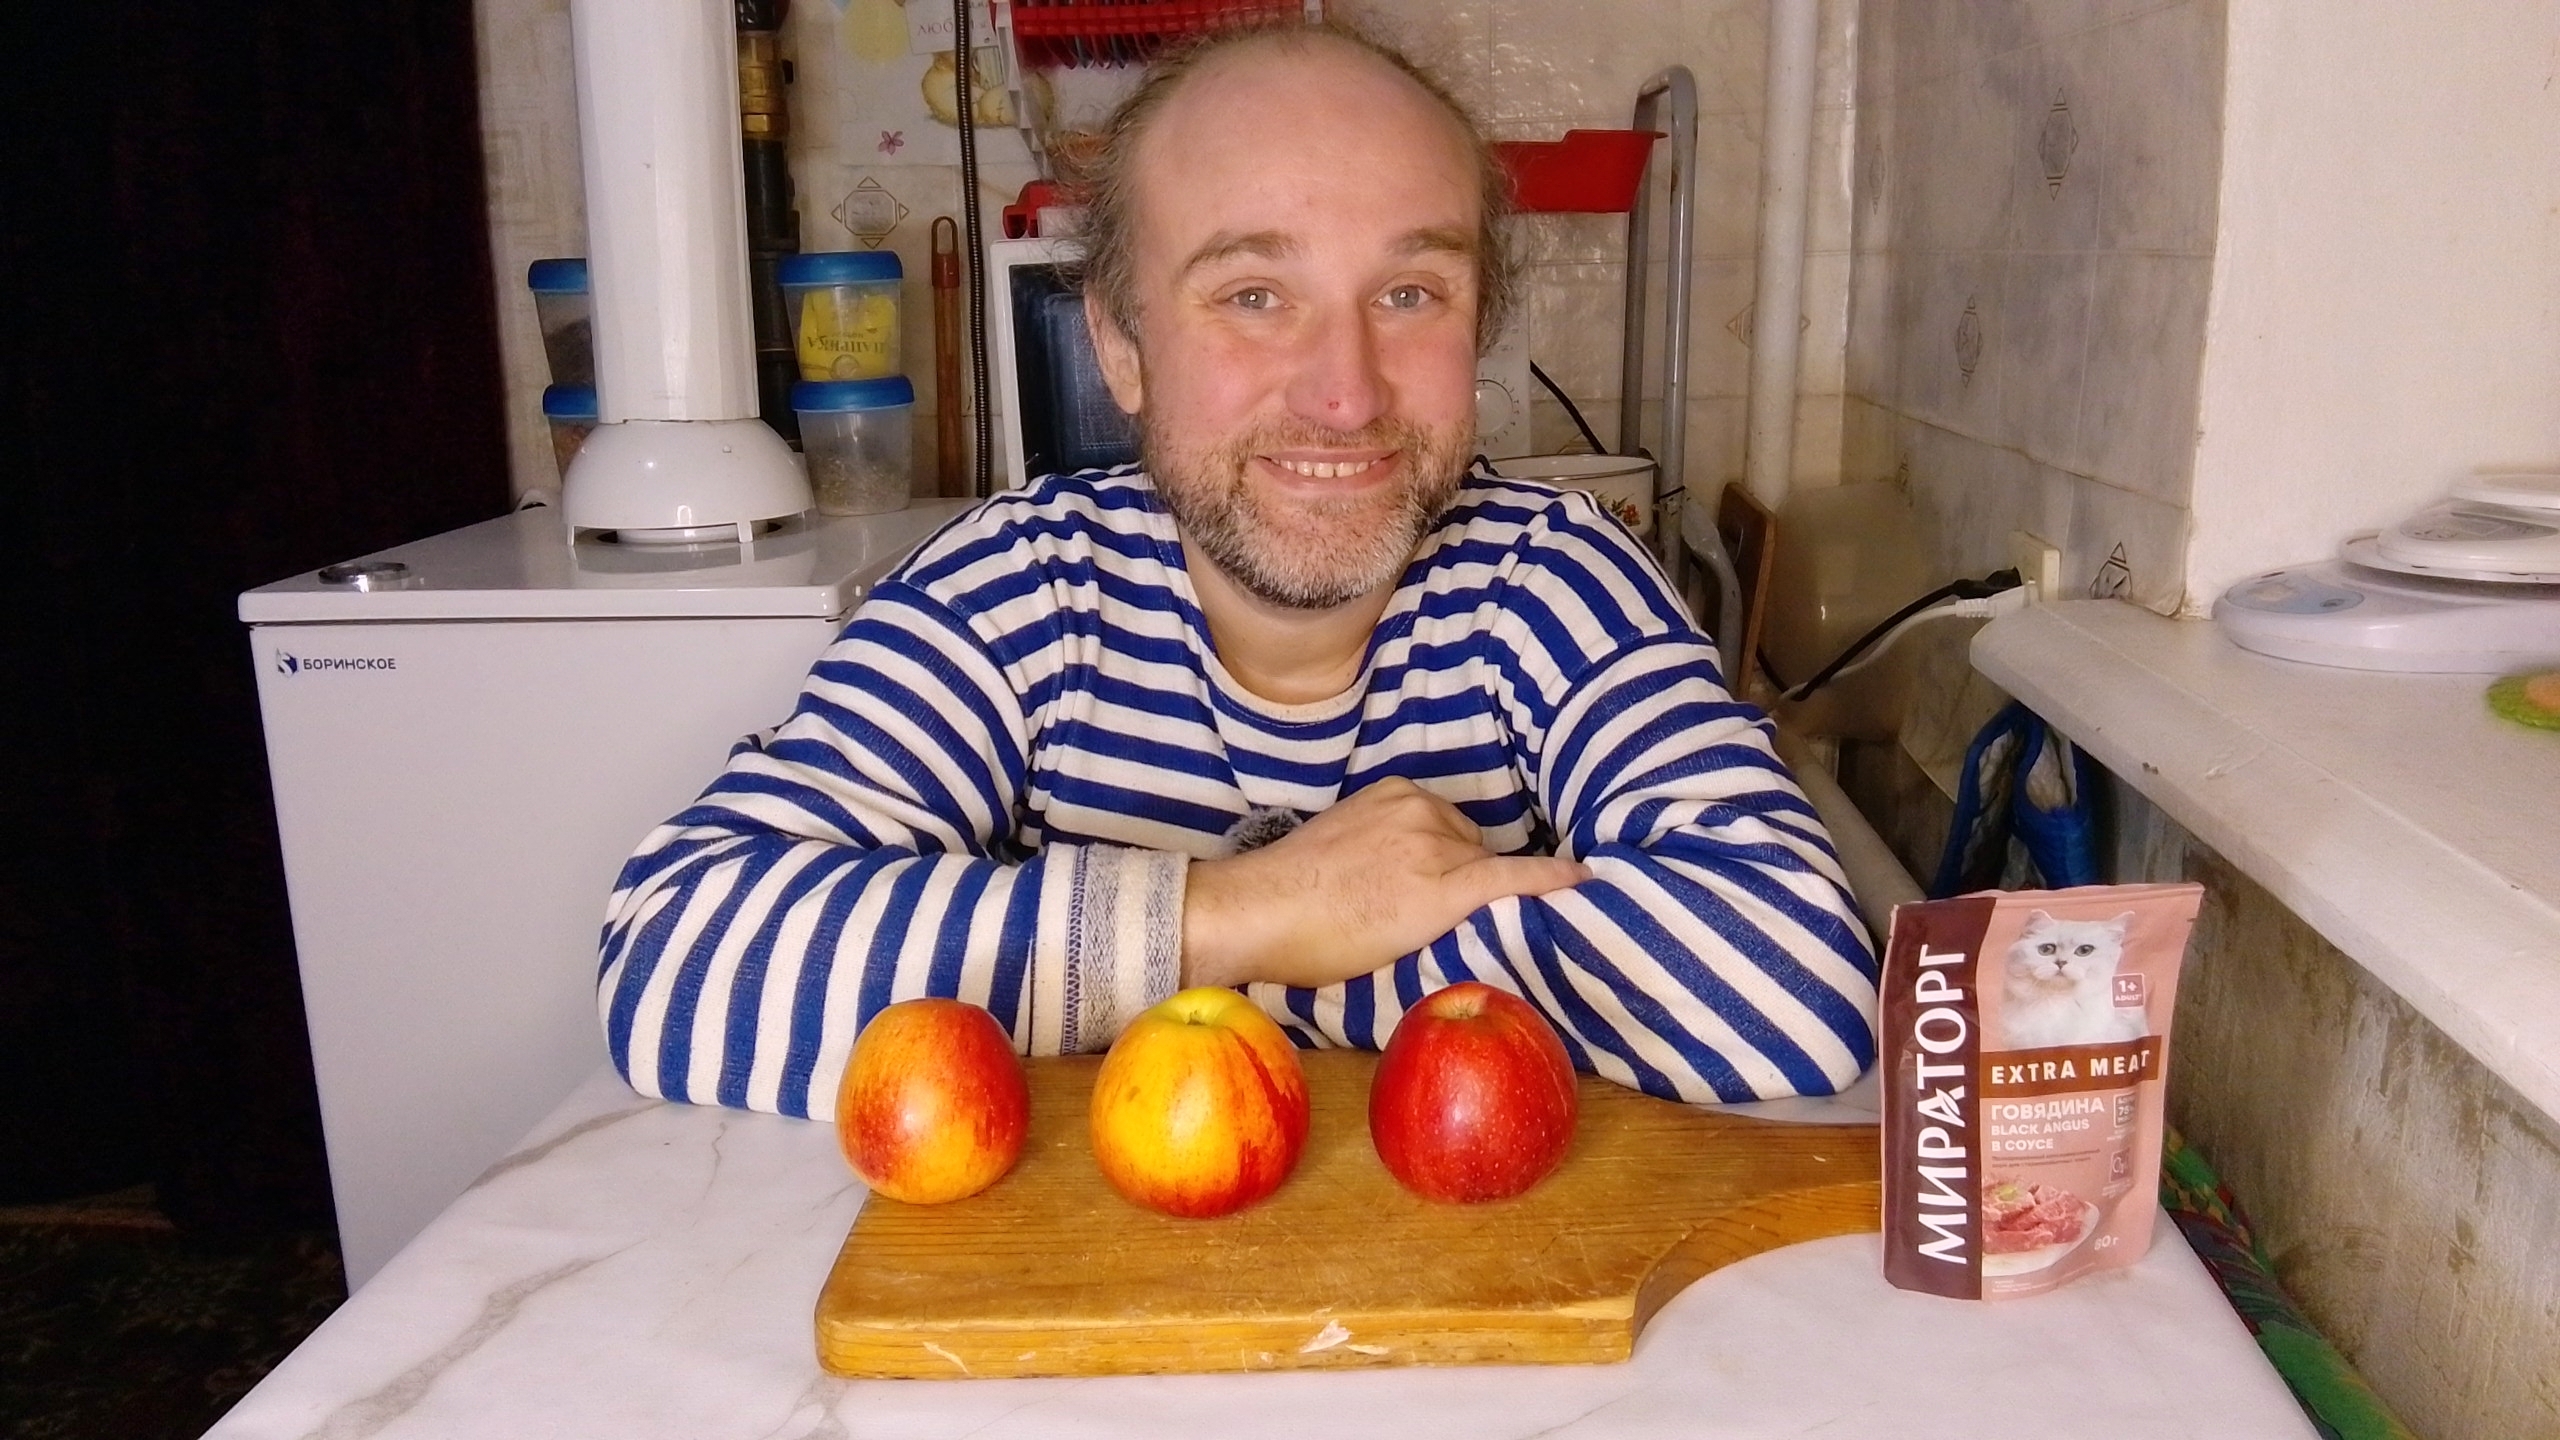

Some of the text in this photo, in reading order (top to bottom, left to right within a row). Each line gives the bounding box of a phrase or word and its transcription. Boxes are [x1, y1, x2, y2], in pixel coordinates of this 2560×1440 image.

[303, 658, 396, 670] БОРИНСКОЕ
[1991, 1050, 2149, 1084] EXTRA MEAT
[1914, 944, 1967, 1264] МИРАТОРГ
[1991, 1097, 2105, 1120] ГОВЯДИНА
[1991, 1119, 2090, 1136] BLACK ANGUS
[1991, 1138, 2054, 1151] В СОУСЕ
